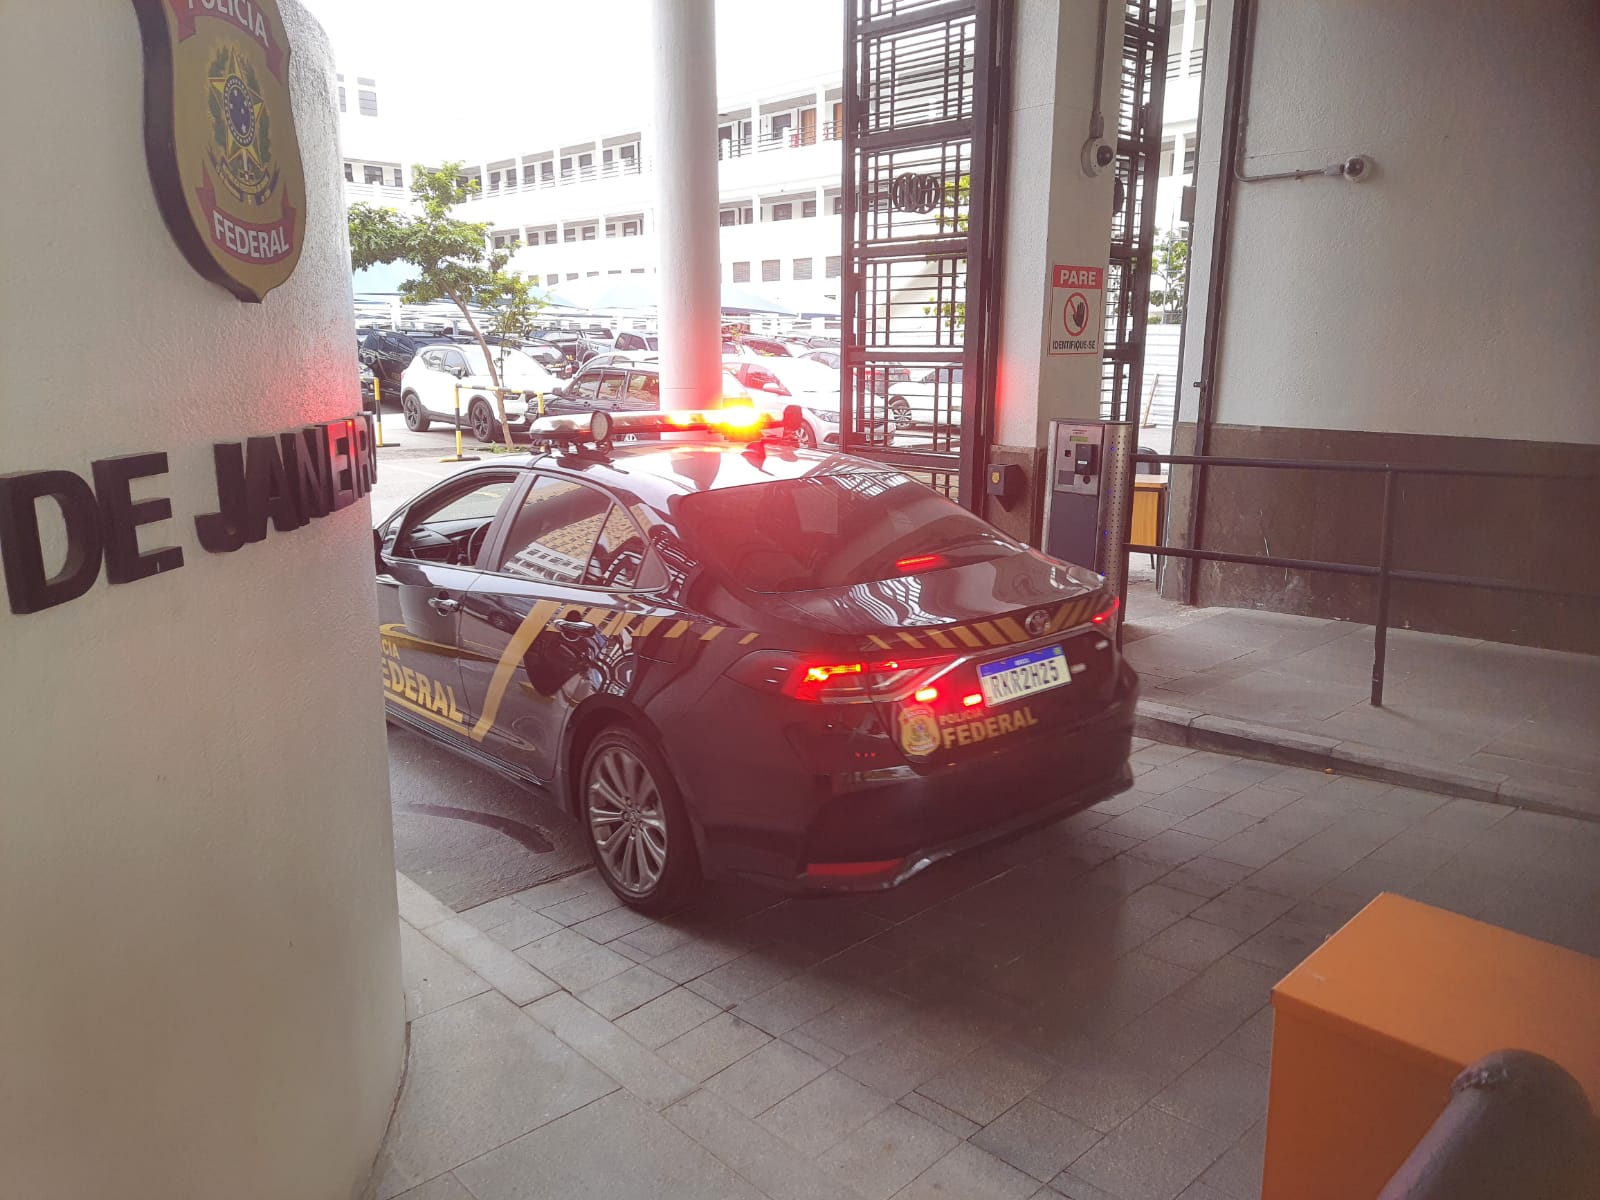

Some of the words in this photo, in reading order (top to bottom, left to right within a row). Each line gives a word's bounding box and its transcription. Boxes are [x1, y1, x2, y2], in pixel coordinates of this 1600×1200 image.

[212, 209, 289, 259] FEDERAL
[1060, 269, 1097, 286] PARE
[1052, 340, 1096, 352] IDENTIFIQUE-SE
[0, 452, 185, 614] DE
[382, 657, 464, 723] EDERAL
[942, 707, 1038, 749] FEDERAL
